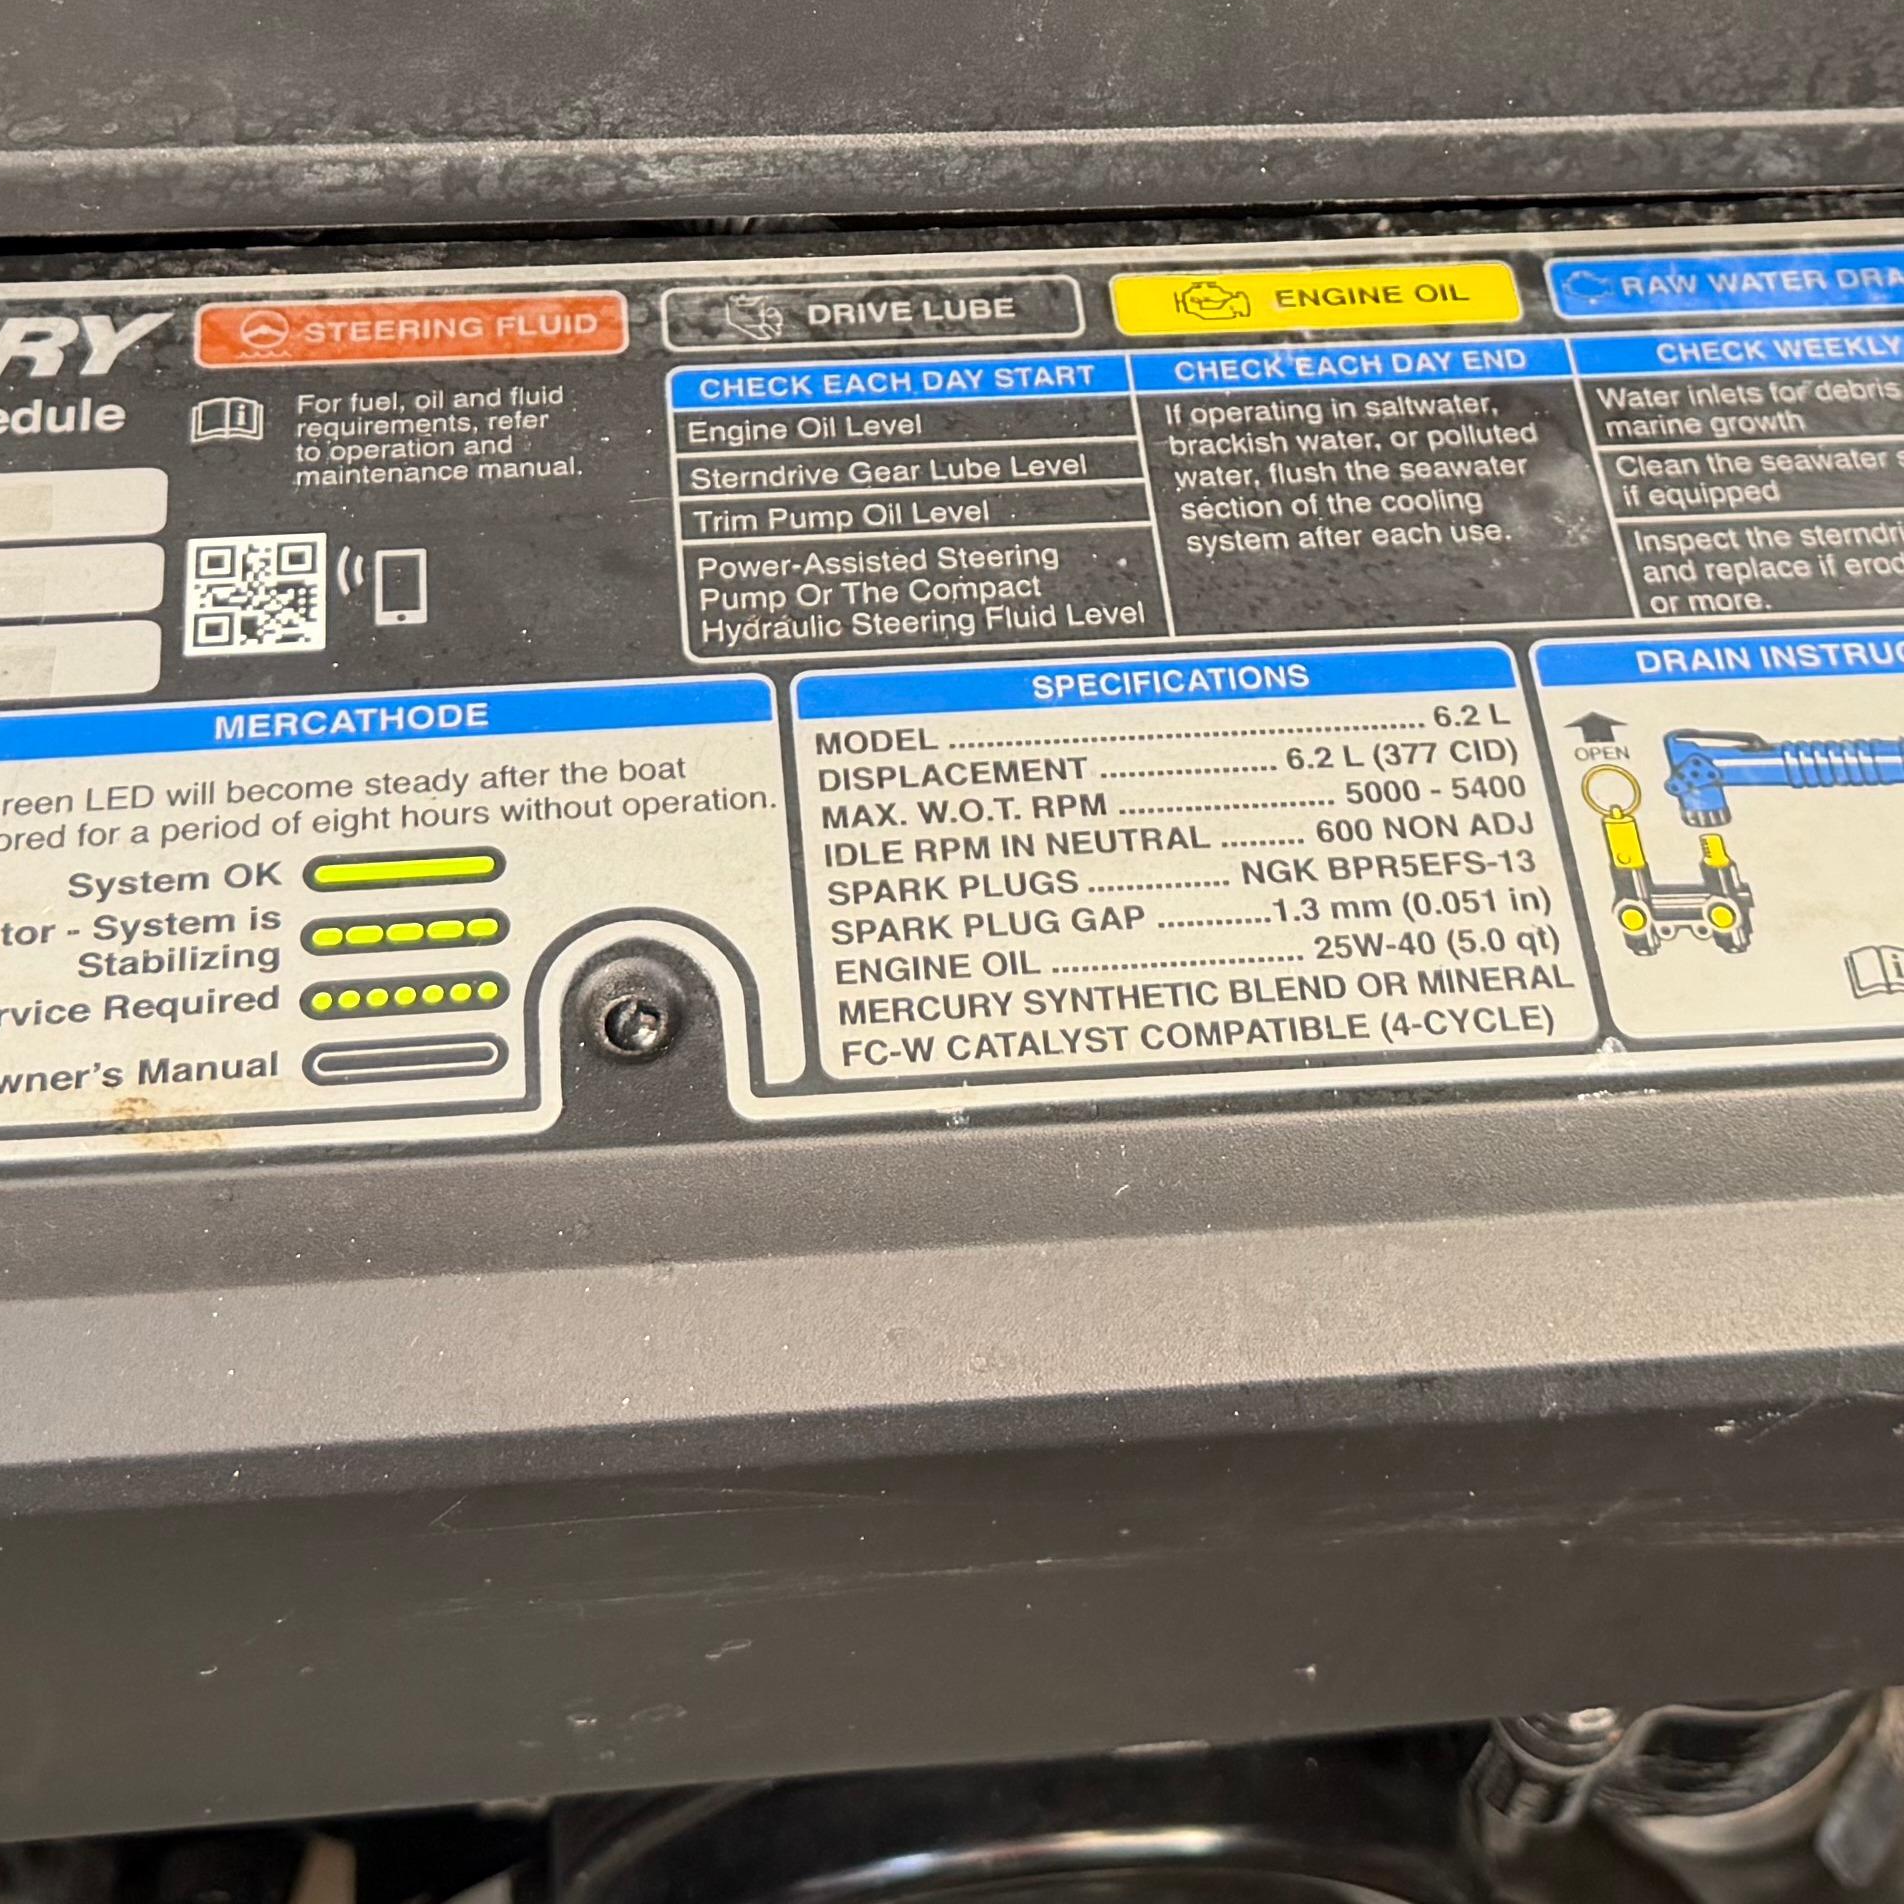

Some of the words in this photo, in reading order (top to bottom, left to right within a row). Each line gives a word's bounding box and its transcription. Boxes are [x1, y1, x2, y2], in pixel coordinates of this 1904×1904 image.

[1274, 284, 1404, 309] ENGINE
[1413, 283, 1471, 304] OIL
[1619, 273, 1698, 298] RAW
[1705, 269, 1830, 295] WATER
[302, 317, 484, 343] STEERING
[496, 311, 599, 339] FLUID
[807, 300, 914, 327] DRIVE
[921, 296, 1017, 322] LUBE
[1173, 358, 1286, 382] CHECK
[1289, 353, 1384, 378] EACH
[1390, 350, 1453, 375] DAY
[1461, 347, 1528, 372] END
[1655, 339, 1768, 367] CHECK
[1772, 334, 1901, 361] WEEKLY
[698, 374, 814, 402] CHECK
[823, 371, 913, 396] EACH
[921, 367, 984, 394] DAY
[994, 363, 1096, 390] START
[1594, 386, 1681, 411] Water
[1686, 382, 1765, 407] inlets
[1768, 381, 1812, 405] for
[1813, 377, 1903, 403] debris
[687, 418, 788, 449] Engine
[796, 415, 837, 440] Oil
[845, 412, 923, 438] Level
[1164, 402, 1182, 426] If
[1189, 399, 1324, 430] operating
[1329, 396, 1358, 420] in
[1363, 393, 1499, 420] saltwater,
[690, 463, 840, 492] Sterndrive
[847, 460, 921, 485] Gear
[929, 456, 1002, 482] Lube
[1009, 452, 1088, 479] Level
[691, 509, 759, 534] Trim
[767, 506, 854, 534] Pump
[861, 501, 903, 528] Oil
[911, 498, 990, 526] Level
[697, 547, 928, 581] Power-Assisted
[936, 545, 1060, 572] Steering
[1634, 645, 1753, 676] DRAIN
[1031, 662, 1311, 701] SPECIFICATIONS
[215, 703, 489, 740] MERCATHODE
[814, 726, 940, 757] MODEL
[1432, 703, 1482, 729] 6.2
[1488, 702, 1512, 726] L
[817, 755, 1089, 793] DISPLACEMENT
[1285, 745, 1335, 771] 6.2
[1342, 743, 1366, 768] L
[1372, 741, 1438, 774] (377
[1448, 736, 1519, 768] CID)
[1573, 745, 1632, 763] OPEN
[85, 783, 155, 813] LED
[165, 779, 216, 808] will
[225, 778, 354, 805] become
[364, 766, 470, 802] steady
[479, 763, 551, 791] after
[558, 759, 609, 786] the
[618, 756, 687, 784] boat
[821, 801, 908, 831] MAX.
[916, 795, 1022, 826] W.O.T.
[1031, 791, 1108, 820] RPM
[1345, 778, 1422, 806] 5000
[1450, 773, 1527, 801] 5400
[76, 821, 122, 848] for
[129, 824, 150, 845] a
[160, 811, 261, 850] period
[270, 809, 303, 837] of
[311, 805, 391, 840] eight
[400, 803, 491, 830] hours
[499, 793, 614, 824] without
[621, 786, 777, 822] operation.
[823, 838, 905, 869] IDLE
[914, 834, 991, 864] RPM
[1000, 832, 1036, 859] IN
[1045, 824, 1212, 857] NEUTRAL
[1315, 817, 1374, 844] 600
[1382, 812, 1460, 841] NON
[1469, 810, 1535, 838] ADJ
[67, 870, 210, 905] System
[223, 860, 283, 890] OK
[826, 874, 949, 907] SPARK
[958, 868, 1080, 900] PLUGS
[1240, 856, 1320, 886] NGK
[1326, 848, 1537, 882] BPR5EFS-13
[92, 911, 236, 947] System
[249, 904, 282, 932] is
[830, 913, 954, 947] SPARK
[962, 908, 1061, 939] PLUG
[1070, 904, 1146, 934] GAP
[1272, 896, 1321, 924] 1.3
[1330, 898, 1393, 921] mm
[1401, 887, 1497, 924] (0.051
[1509, 884, 1552, 918] in)
[77, 942, 281, 980] Stabilizing
[834, 952, 973, 986] ENGINE
[981, 949, 1042, 979] OIL
[1313, 929, 1437, 961] 25W-40
[1446, 926, 1507, 962] (5.0
[1515, 923, 1561, 958] qt)
[103, 983, 280, 1025] Required
[838, 990, 1014, 1027] MERCURY
[1022, 979, 1220, 1017] SYNTHETIC
[1228, 973, 1347, 1005] BLEND
[1356, 970, 1409, 999] OR
[1416, 963, 1576, 996] MINERAL
[841, 1035, 936, 1068] FC-W
[946, 1024, 1130, 1062] CATALYST
[1139, 1012, 1371, 1051] COMPATIBLE
[1380, 1004, 1555, 1045] (4-CYCLE)
[137, 1049, 279, 1087] Manual
